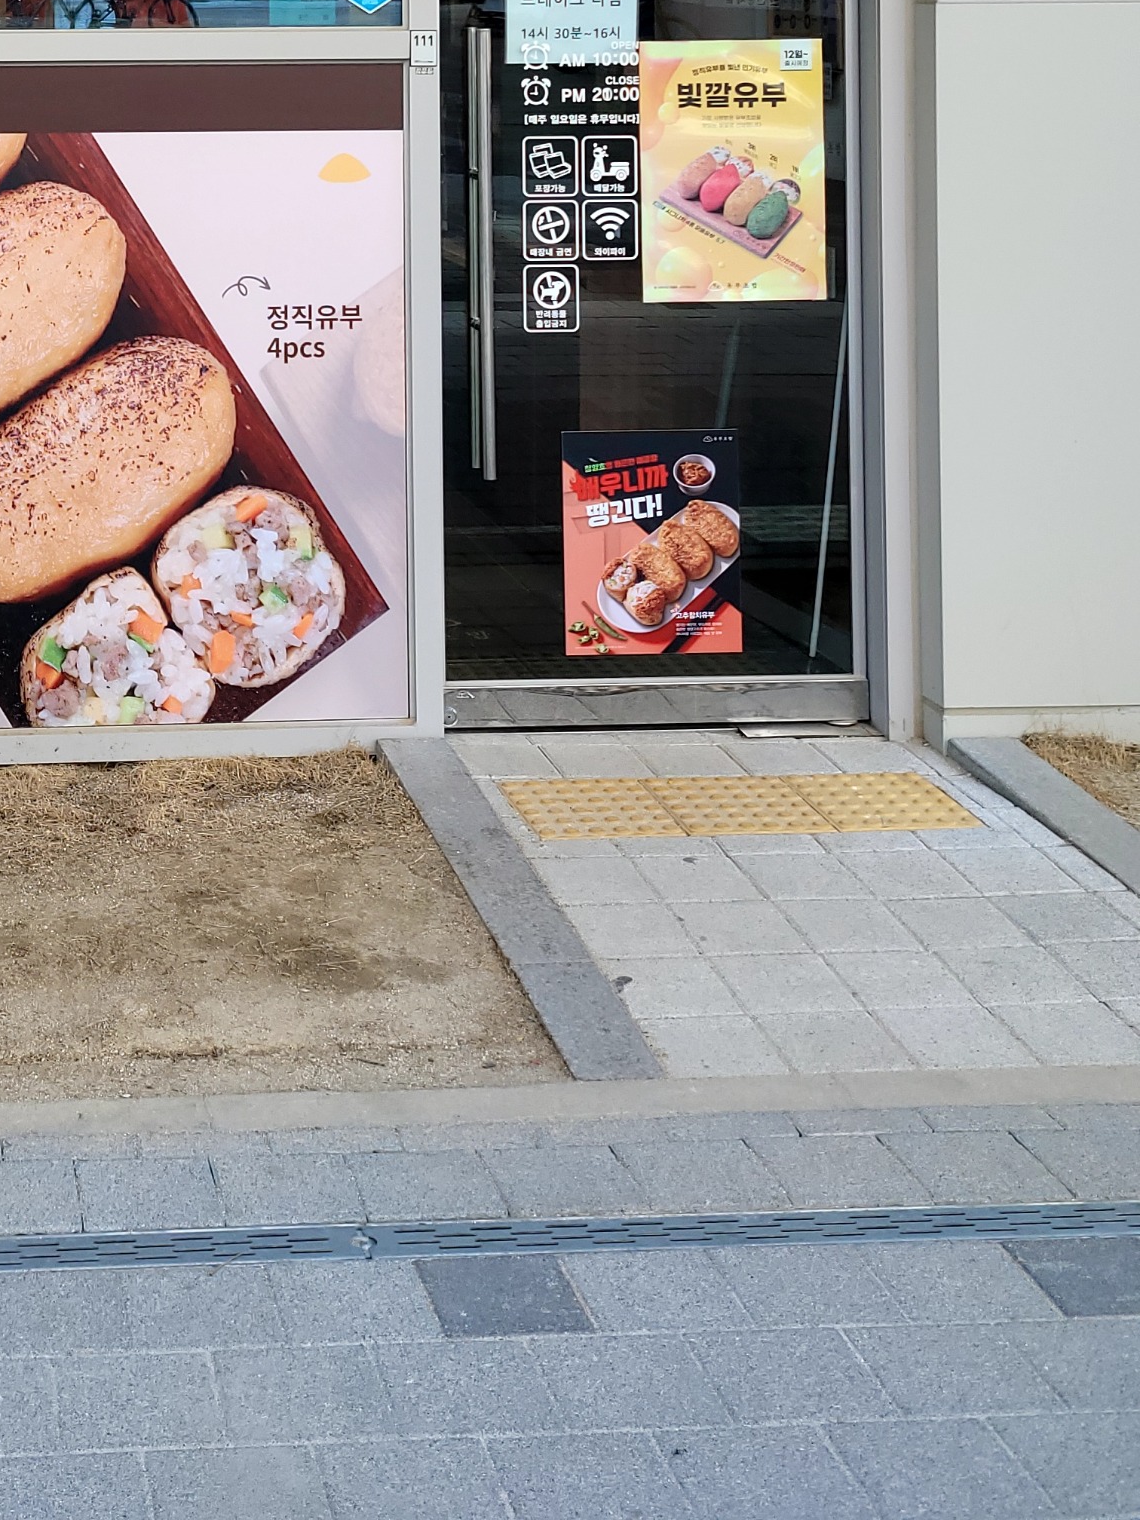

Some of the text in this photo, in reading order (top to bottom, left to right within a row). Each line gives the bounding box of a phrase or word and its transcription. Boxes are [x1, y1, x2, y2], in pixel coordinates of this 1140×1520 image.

[521, 26, 620, 40] 14시 30분~16시
[414, 35, 433, 46] 111
[611, 41, 639, 49] OPEN
[559, 52, 639, 67] AM 10:00
[605, 76, 640, 85] CLOSE
[561, 88, 586, 102] PM
[267, 305, 363, 330] 정직유부
[267, 338, 326, 363] 4pcs
[586, 493, 663, 528] 땡긴다!
